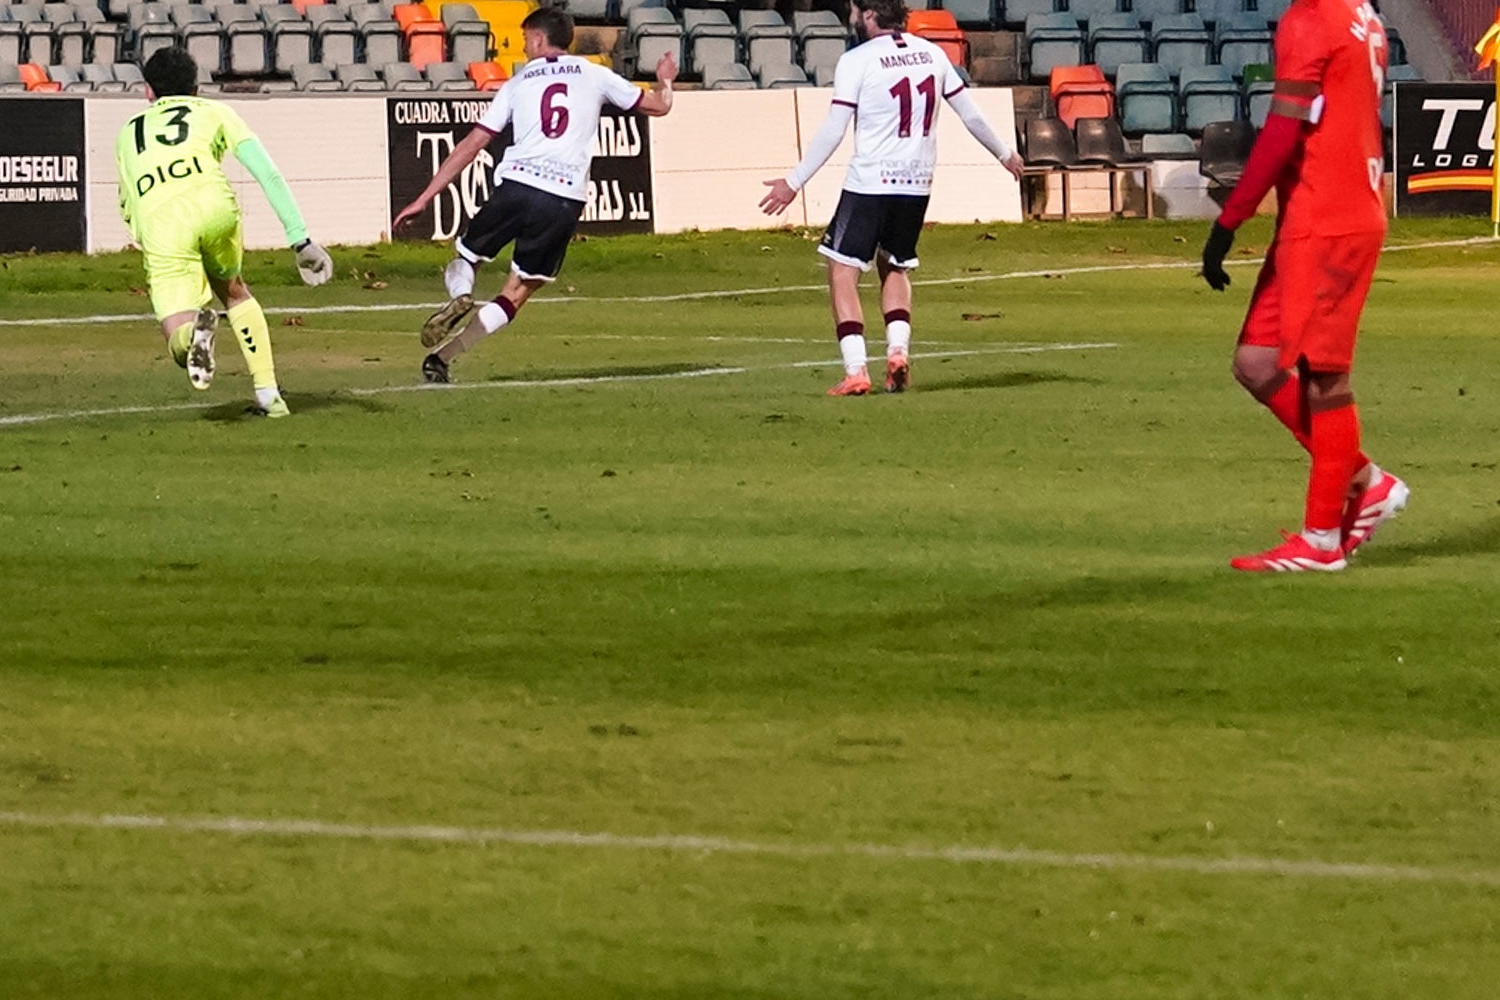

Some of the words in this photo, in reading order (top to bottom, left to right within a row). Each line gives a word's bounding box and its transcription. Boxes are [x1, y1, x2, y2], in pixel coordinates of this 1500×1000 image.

[551, 64, 582, 75] LARA
[879, 51, 934, 69] MANCEBO
[395, 101, 450, 124] CUADRA
[451, 101, 491, 124] TORR
[540, 82, 569, 139] 6
[888, 73, 935, 138] 11
[128, 105, 192, 155] 13
[1412, 154, 1495, 168] LOGI
[136, 156, 203, 197] DIGI
[38, 187, 78, 202] PRIVADA
